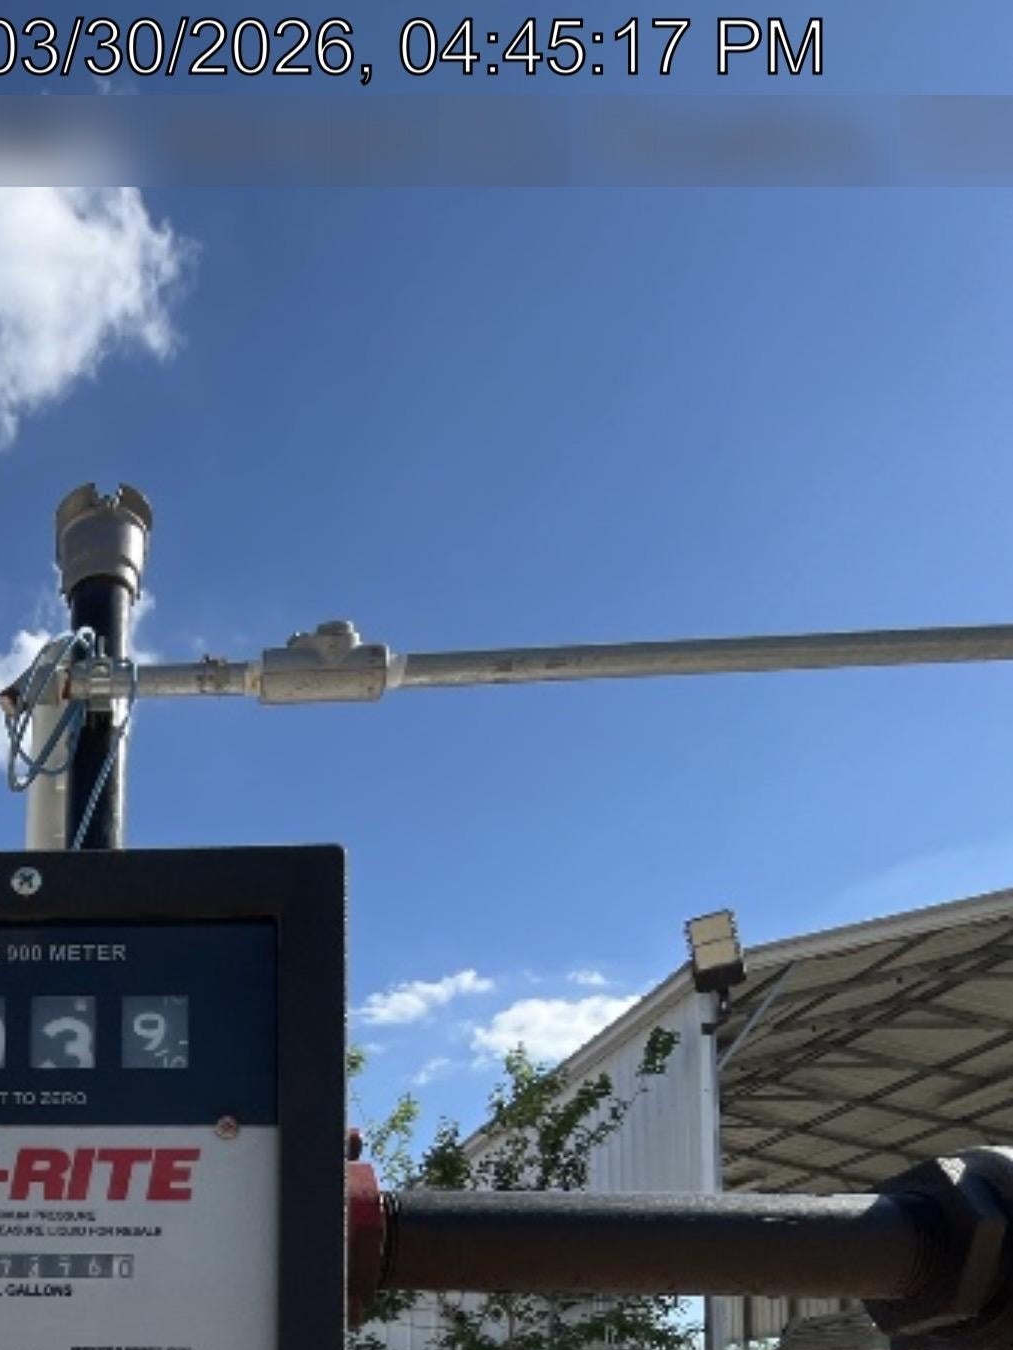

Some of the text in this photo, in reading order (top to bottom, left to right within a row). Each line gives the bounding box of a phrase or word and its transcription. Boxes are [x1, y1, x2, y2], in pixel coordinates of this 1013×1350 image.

[7, 945, 42, 961] 900
[49, 944, 126, 961] METER
[13, 1091, 36, 1105] TO
[40, 1091, 87, 1105] ZERO
[7, 1283, 73, 1297] GALLONS
